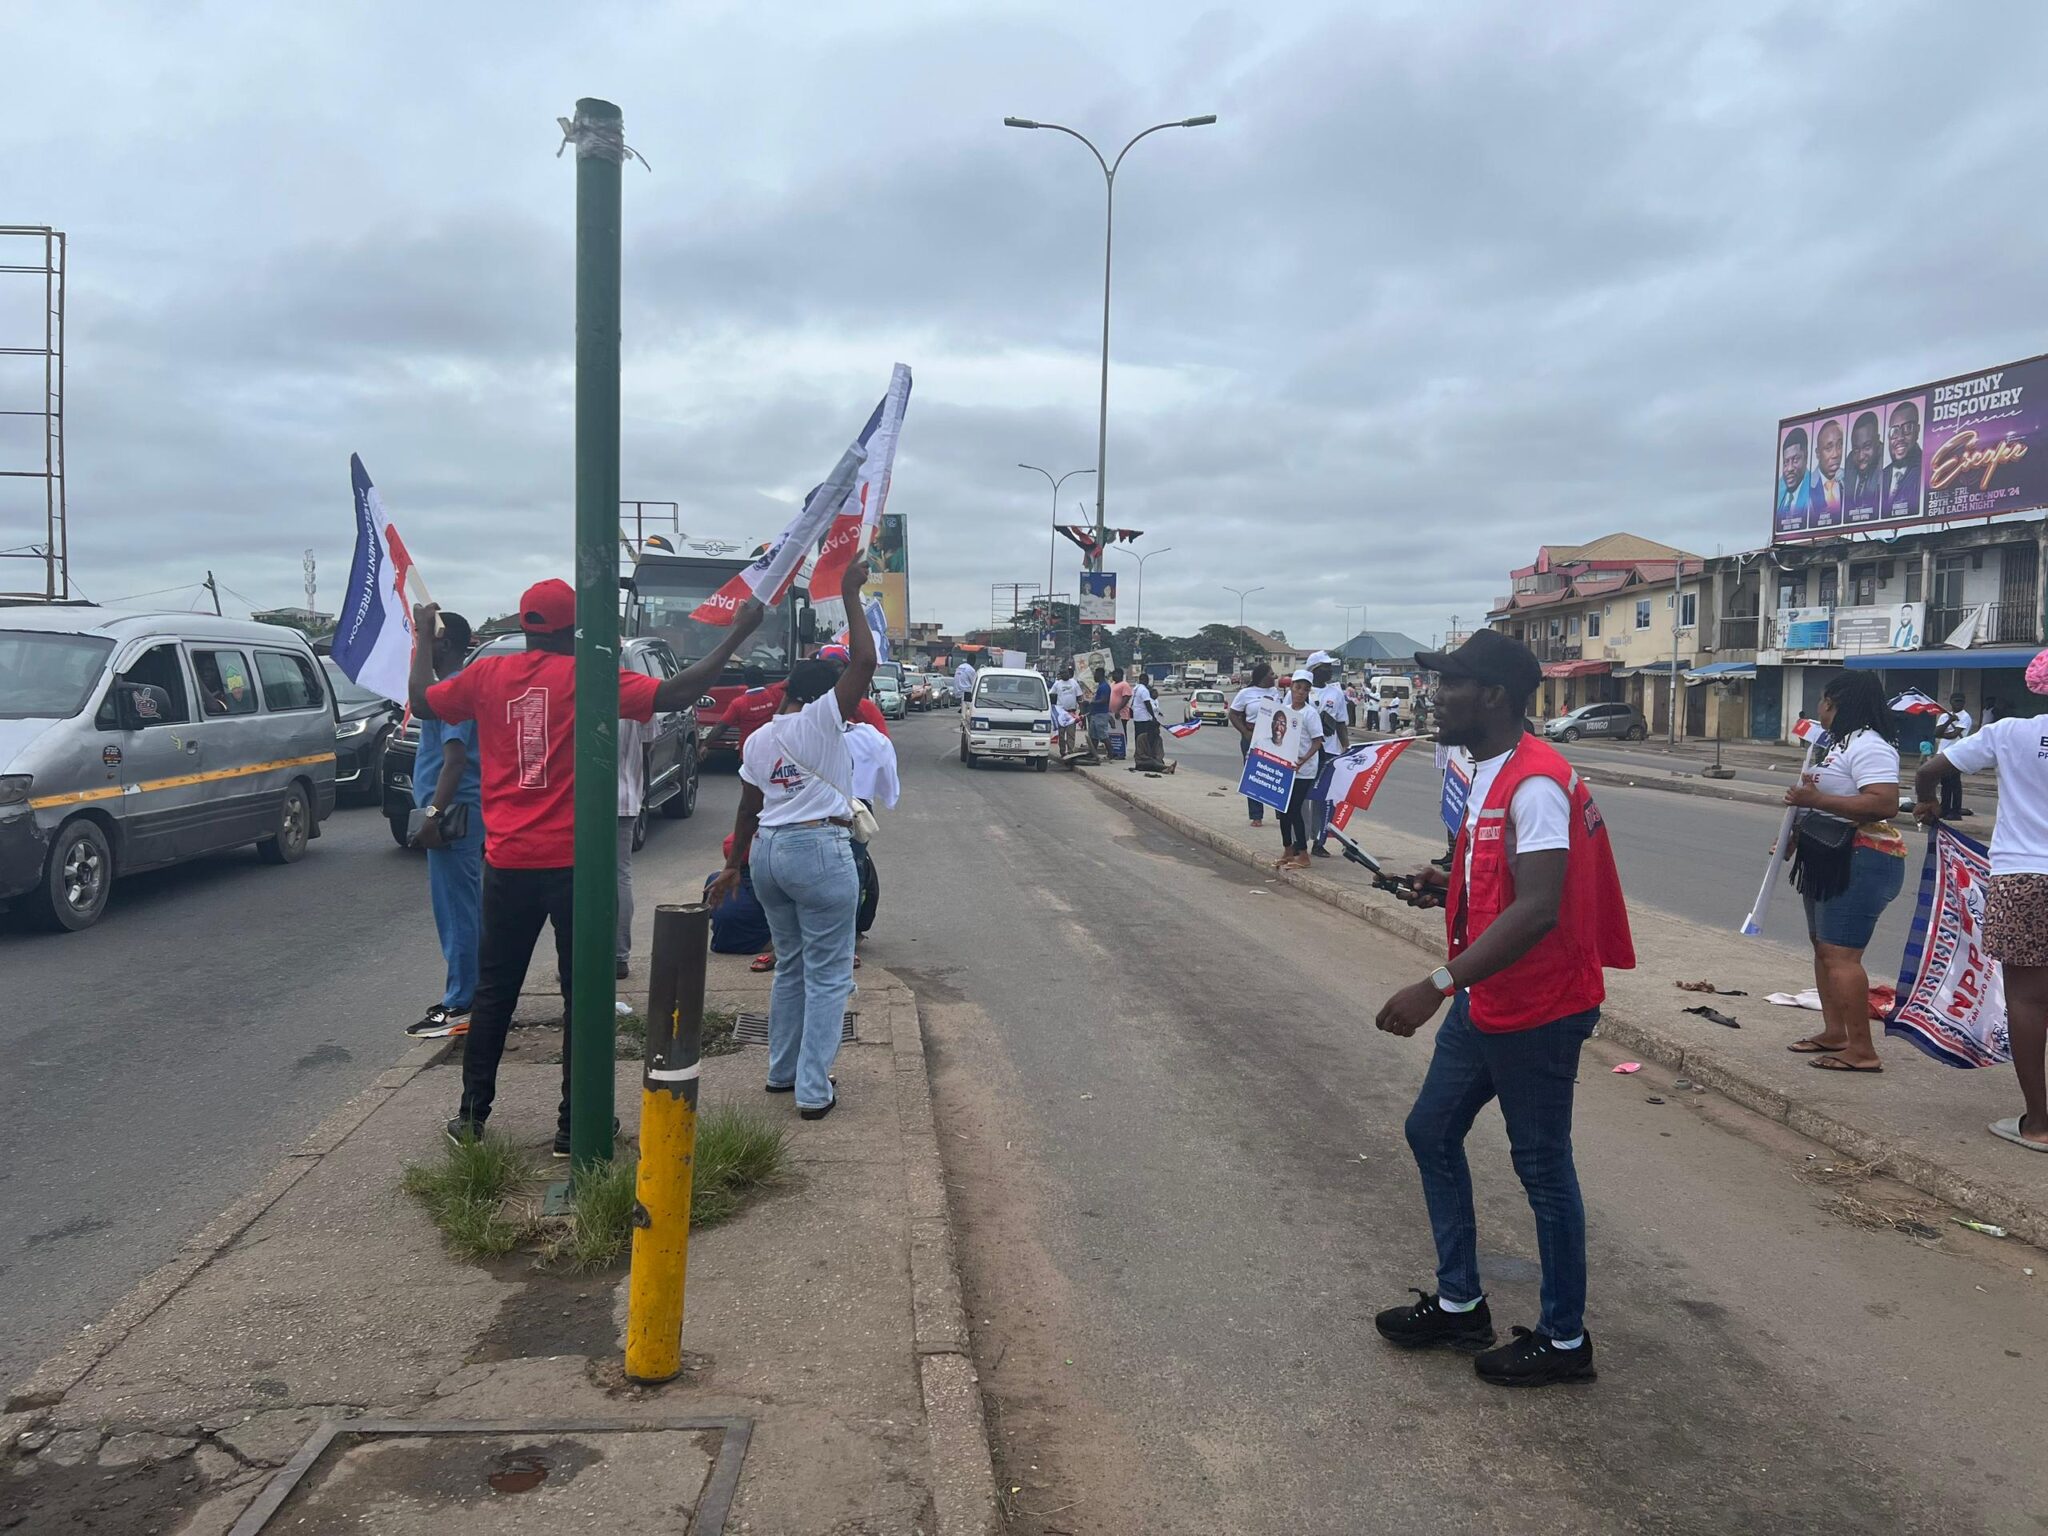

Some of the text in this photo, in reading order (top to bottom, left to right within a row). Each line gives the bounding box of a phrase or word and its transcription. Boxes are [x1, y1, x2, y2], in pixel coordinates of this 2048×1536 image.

[1933, 372, 2004, 404] DESTINY
[1932, 386, 2024, 422] DISCOVERY
[1928, 497, 1949, 509] 29TH
[1954, 494, 1968, 505] 1ST
[1928, 499, 1996, 517] 6PM EACH NIGHT
[366, 572, 376, 587] IN
[348, 587, 372, 646] FREEDOM
[1586, 721, 1609, 731] YANGO
[507, 687, 549, 789] 1
[1255, 770, 1283, 785] number of
[1256, 760, 1284, 779] Reduce the
[1248, 774, 1272, 790] Ministers
[1276, 785, 1285, 796] 50
[1361, 775, 1377, 795] PARTY
[1335, 804, 1349, 825] PARTY
[1946, 943, 1984, 1019] NPP
